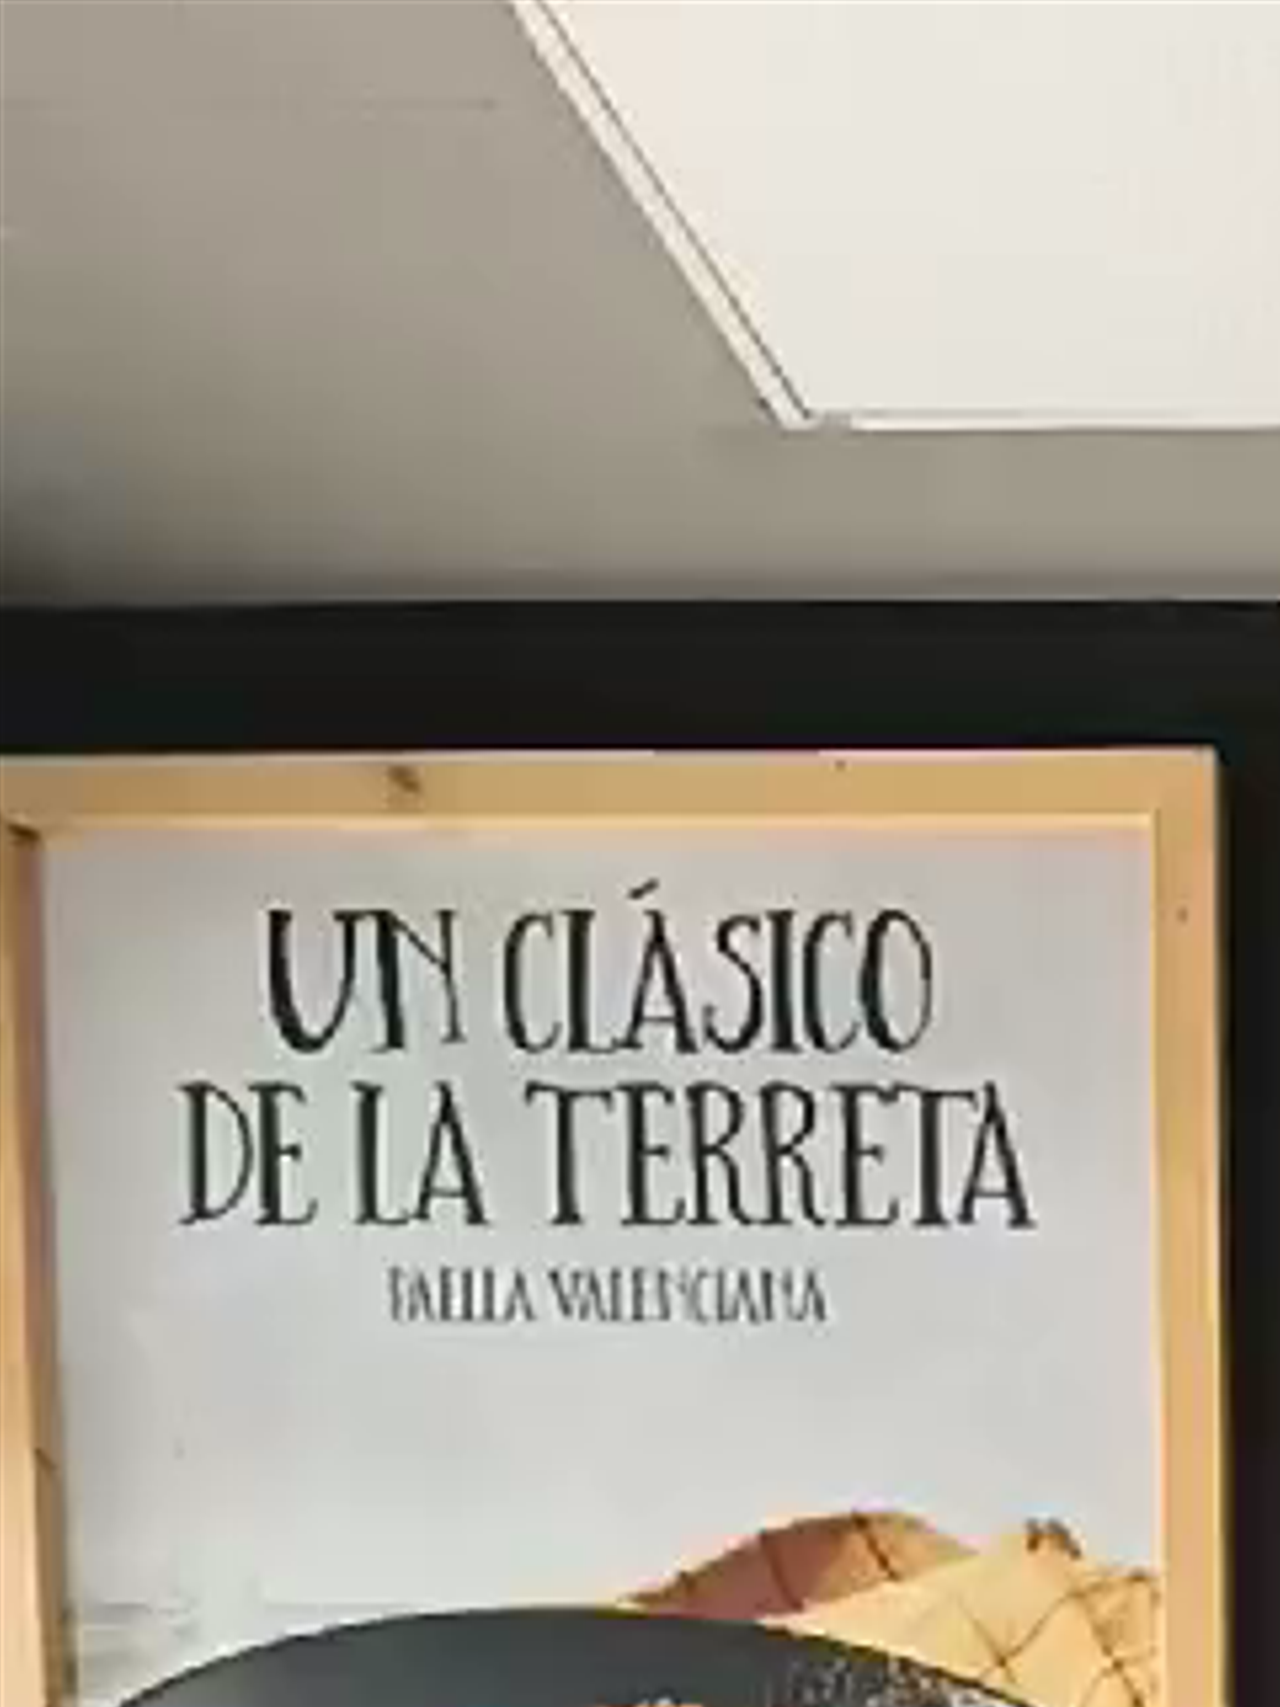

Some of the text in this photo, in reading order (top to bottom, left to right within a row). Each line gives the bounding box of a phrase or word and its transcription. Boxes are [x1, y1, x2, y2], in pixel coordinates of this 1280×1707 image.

[266, 879, 932, 1056] UN CLÁSICO
[181, 1080, 1036, 1228] DE LA TERRETA
[389, 1265, 829, 1326] PAELLA VALENCIANA
